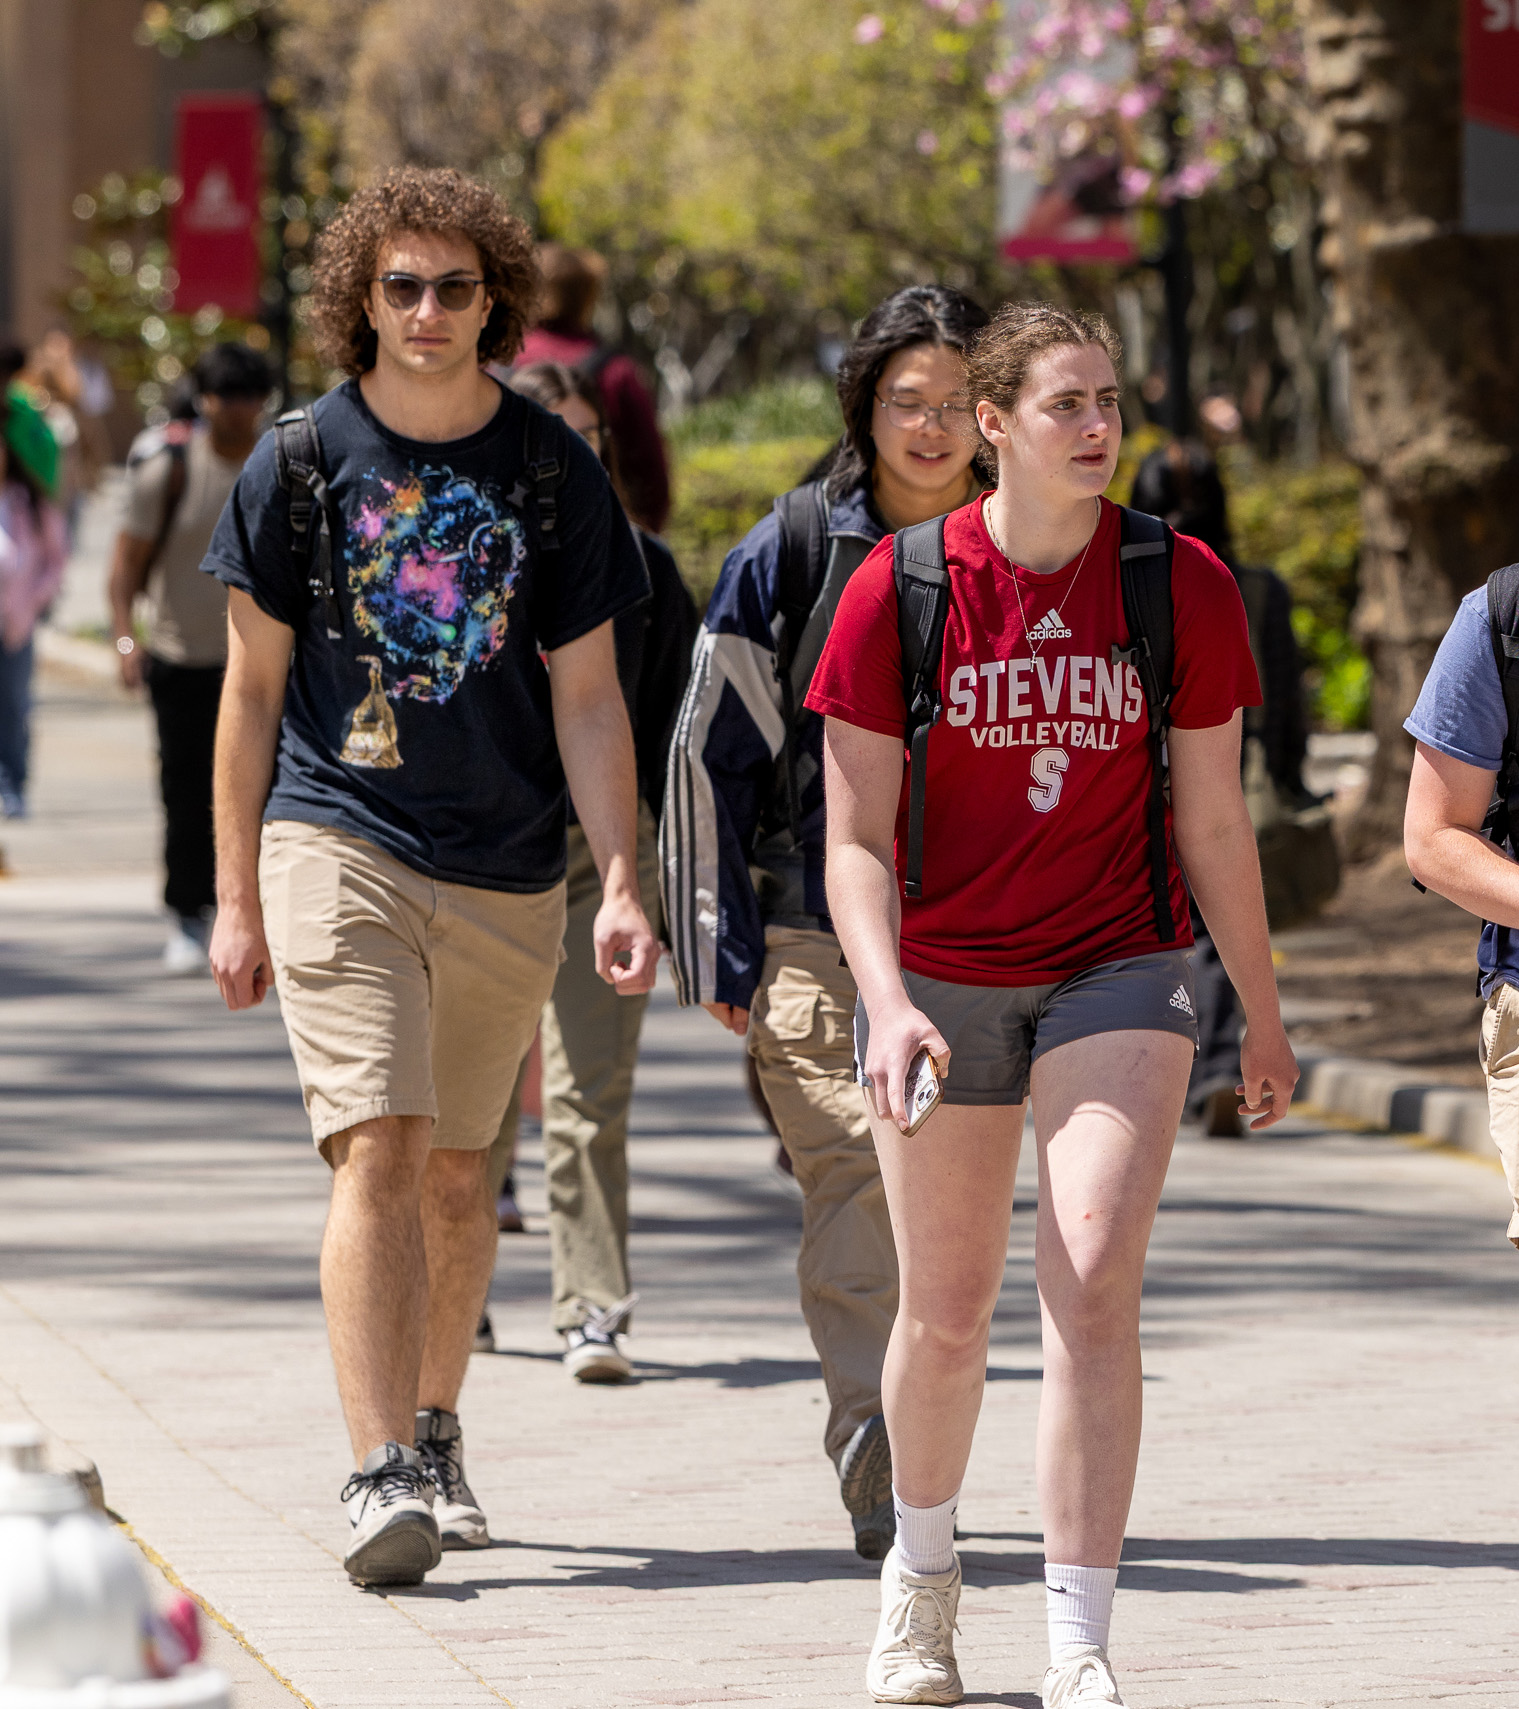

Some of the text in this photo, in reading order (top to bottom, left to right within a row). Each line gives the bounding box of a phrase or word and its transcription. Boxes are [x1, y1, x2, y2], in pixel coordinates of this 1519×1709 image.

[1028, 627, 1073, 641] adidas
[946, 655, 1143, 727] STEVENS
[970, 721, 1120, 751] VOLLEYBALL
[1028, 747, 1070, 813] S
[1169, 998, 1194, 1016] adidas
